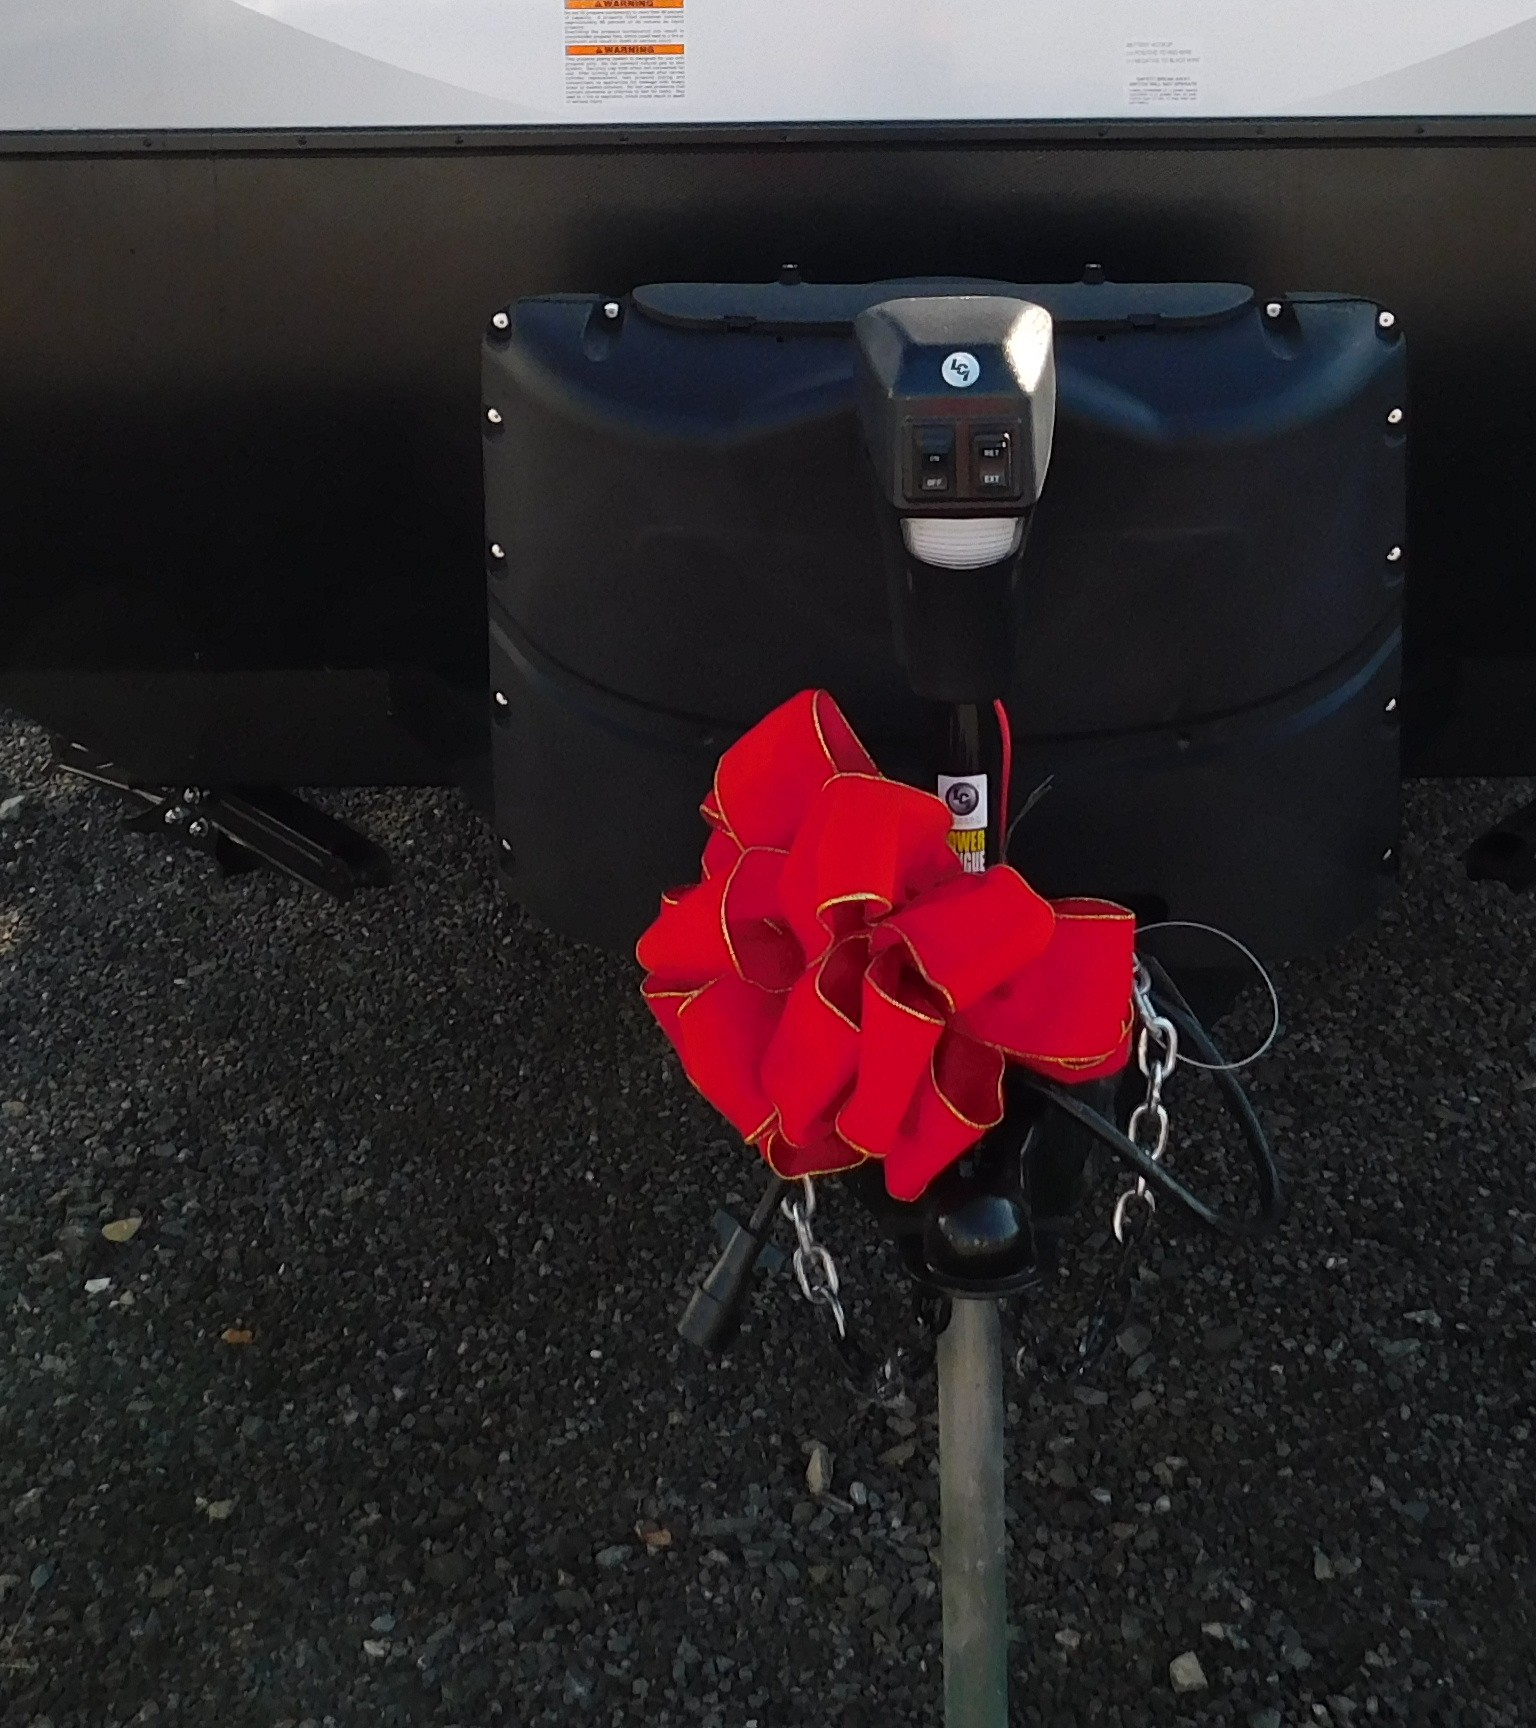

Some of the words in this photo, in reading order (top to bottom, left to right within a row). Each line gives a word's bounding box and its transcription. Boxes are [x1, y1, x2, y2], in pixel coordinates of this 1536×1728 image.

[604, 0, 654, 7] WARNING
[604, 46, 655, 54] WARNING
[926, 478, 943, 487] OFF
[947, 830, 985, 853] OWER
